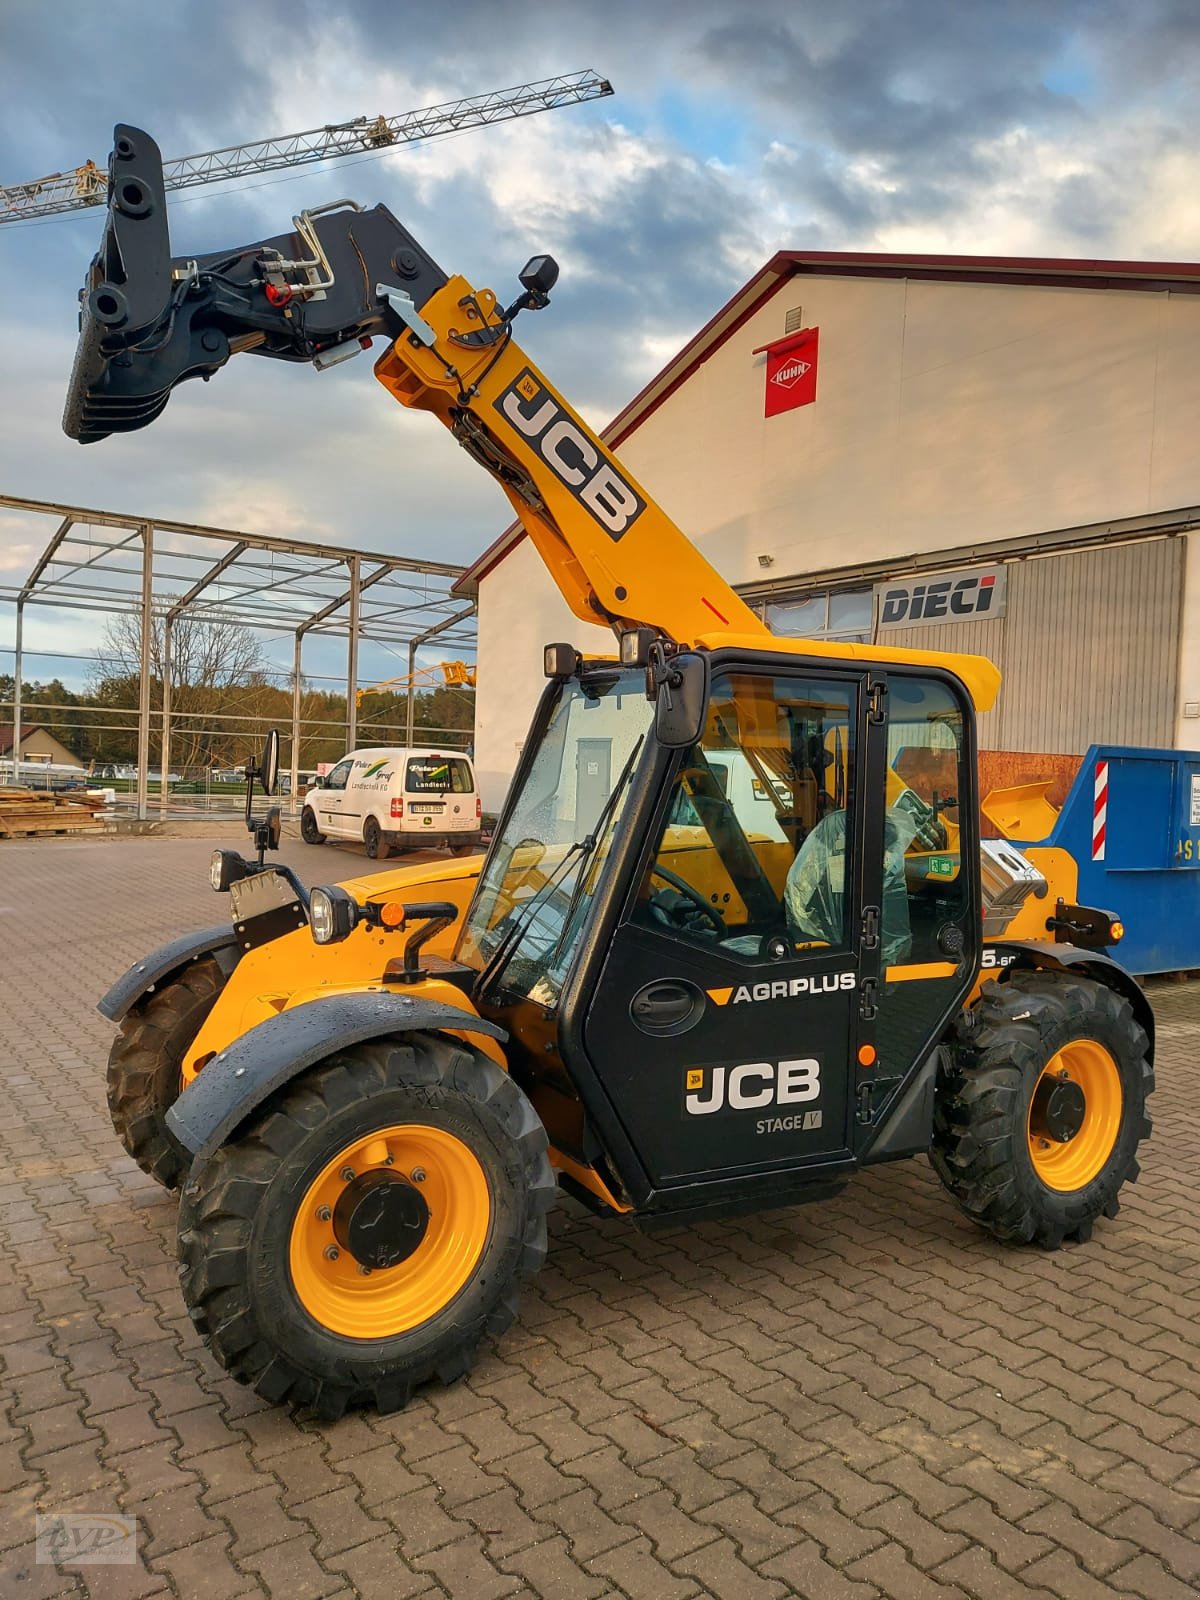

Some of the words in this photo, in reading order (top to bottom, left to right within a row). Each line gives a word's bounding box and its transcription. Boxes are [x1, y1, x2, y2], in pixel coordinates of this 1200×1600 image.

[776, 363, 805, 384] KUHN
[502, 391, 638, 532] JCB
[686, 1058, 821, 1115] JCB
[756, 1114, 802, 1135] STAGE
